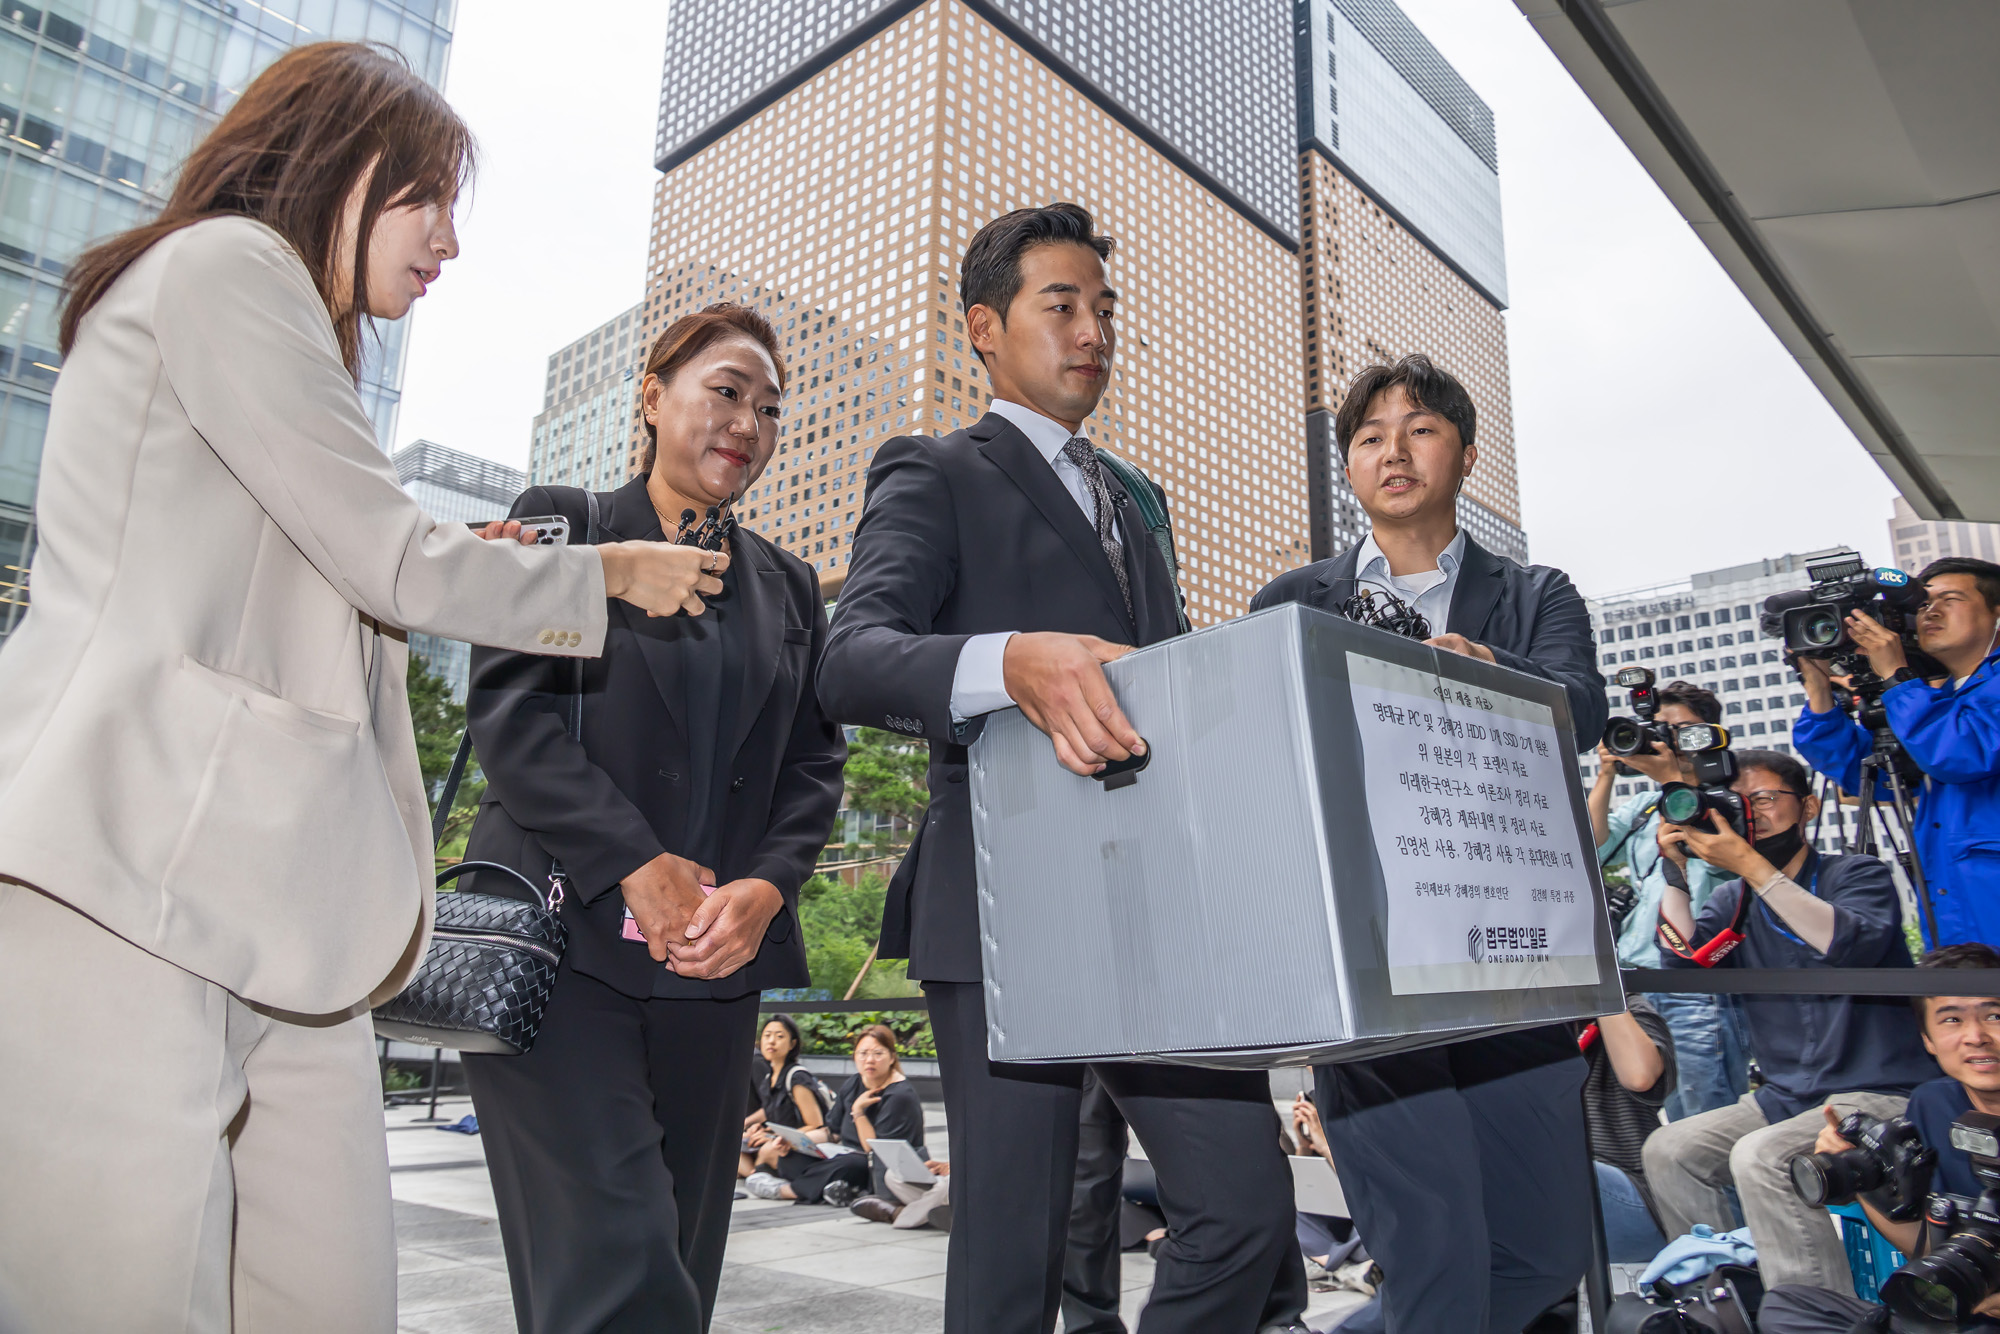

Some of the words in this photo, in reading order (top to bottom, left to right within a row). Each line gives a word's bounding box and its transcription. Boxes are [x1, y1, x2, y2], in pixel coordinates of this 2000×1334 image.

[1455, 691, 1472, 708] 제출
[1373, 703, 1405, 726] 명태균
[1408, 709, 1421, 727] PC
[1424, 714, 1434, 733] 및
[1437, 717, 1464, 738] 강혜경
[1466, 723, 1487, 740] HDD
[1489, 728, 1502, 746] 1개
[1503, 732, 1519, 748] SSD
[1520, 736, 1534, 753] 2개
[1534, 739, 1549, 758] 원본
[1418, 743, 1429, 762] 위
[1433, 746, 1463, 768] 원본의
[1467, 752, 1478, 771] 각
[1482, 755, 1510, 775] 포렌식
[1511, 760, 1529, 778] 자료
[1399, 771, 1474, 798] 미래한국연구소
[1477, 782, 1512, 804] 여론조사
[1515, 789, 1531, 808] 정리
[1533, 793, 1550, 810] 자료
[1418, 805, 1453, 828] 강혜경
[1456, 809, 1497, 832] 계좌내역
[1498, 815, 1509, 834] 및
[1510, 817, 1528, 836] 정리
[1529, 820, 1547, 838] 자료
[1395, 835, 1431, 857] 김영선
[1435, 838, 1460, 860] 사용,
[1463, 841, 1492, 862] 강혜경
[1496, 844, 1513, 864] 사용
[1515, 847, 1526, 866] 각
[1528, 848, 1560, 868] 휴대전화
[1560, 852, 1574, 870] 1대
[1414, 881, 1451, 898] 공익제보자
[1454, 883, 1481, 899] 강혜경의
[1483, 885, 1509, 901] 변호인단
[1531, 888, 1548, 902] 김건희
[1549, 889, 1561, 903] 특검
[1563, 890, 1575, 904] 귀중
[1485, 926, 1548, 950] 법무법인일로
[1660, 923, 1687, 951] Canon
[1488, 954, 1503, 964] ONE
[1505, 954, 1524, 963] ROAD
[1526, 954, 1535, 963] TO
[1537, 954, 1549, 963] WIN
[1708, 939, 1739, 962] PRESS
